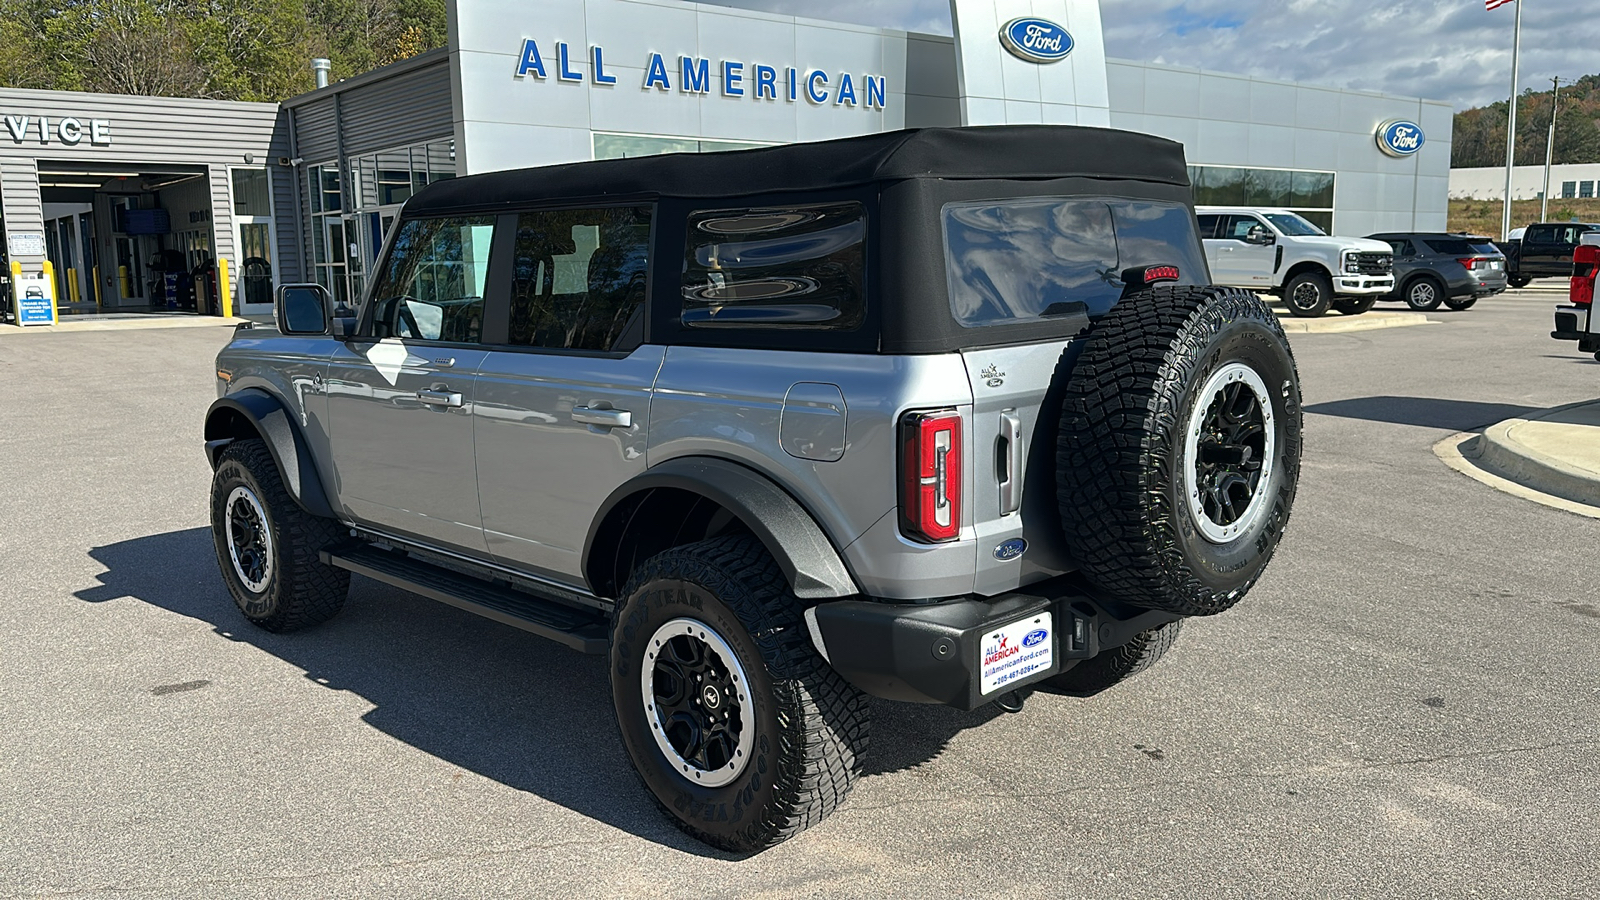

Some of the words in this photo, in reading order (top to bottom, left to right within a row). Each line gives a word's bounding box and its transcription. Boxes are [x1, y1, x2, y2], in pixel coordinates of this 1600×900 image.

[1023, 24, 1062, 52] Ford
[514, 38, 618, 85] ALL
[642, 52, 887, 109] AMERICAN
[5, 115, 112, 145] VICE
[1392, 126, 1419, 148] Ford
[984, 644, 1020, 667] AMERICAN
[984, 648, 1049, 678] AllAmericanFord.com
[985, 645, 999, 657] ALL
